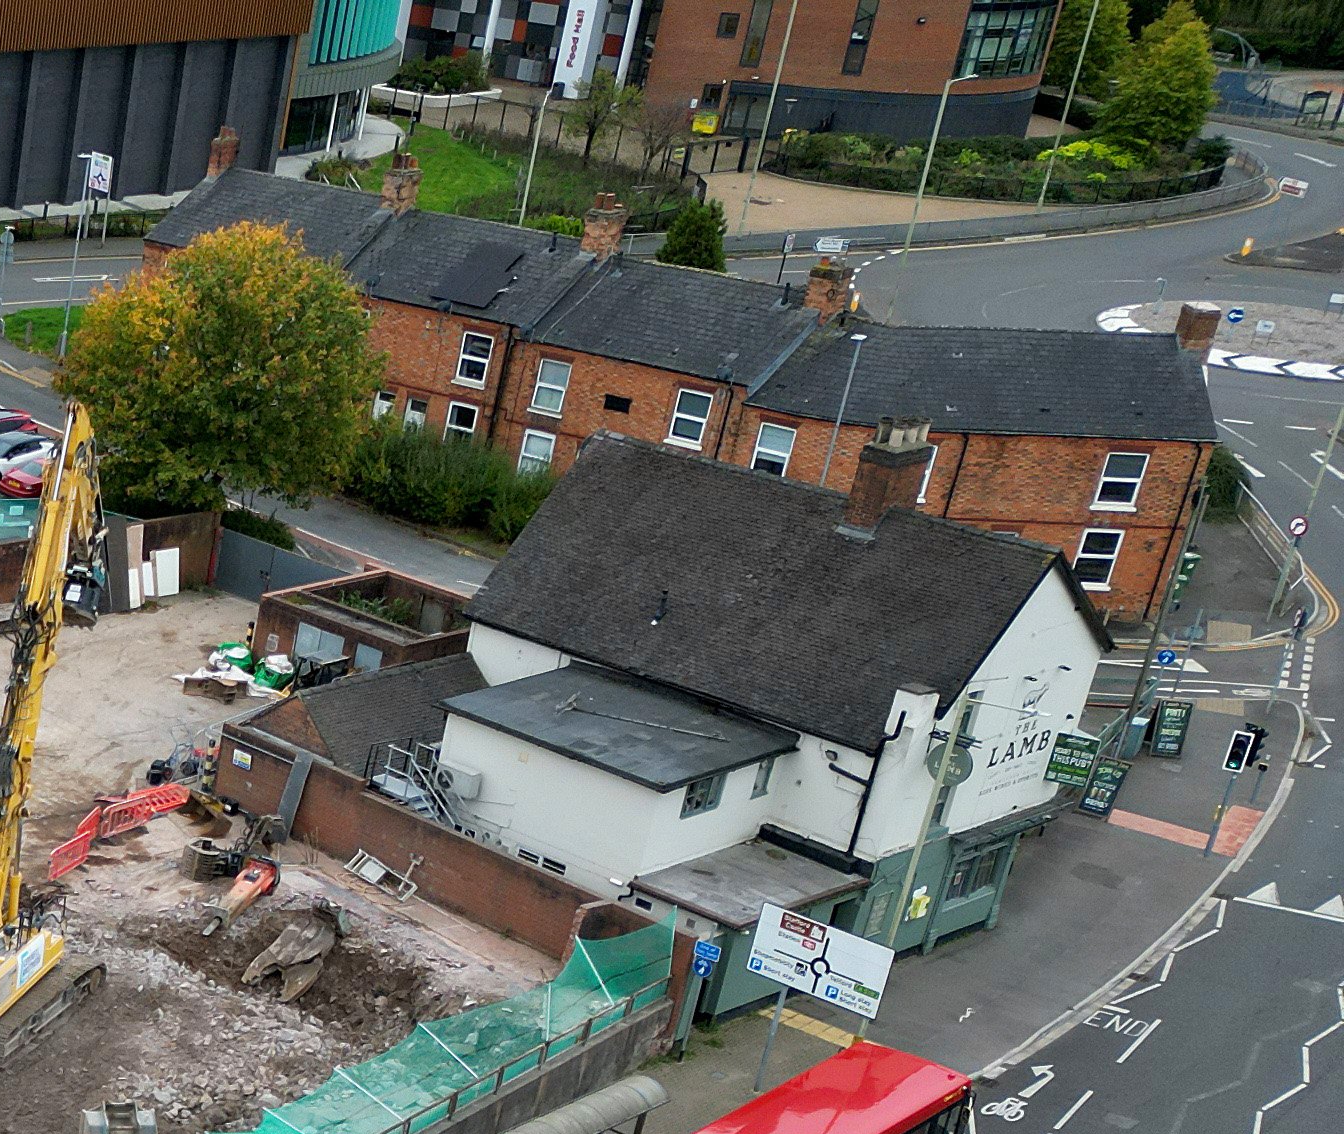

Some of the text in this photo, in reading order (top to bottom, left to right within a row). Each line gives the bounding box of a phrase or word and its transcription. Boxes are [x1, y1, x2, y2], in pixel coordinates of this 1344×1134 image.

[565, 9, 586, 68] Food Hall
[1015, 720, 1038, 736] THE
[987, 729, 1052, 769] LAMB
[934, 759, 962, 776] LMB
[784, 914, 811, 929] Stafford
[1082, 1010, 1150, 1037] END
